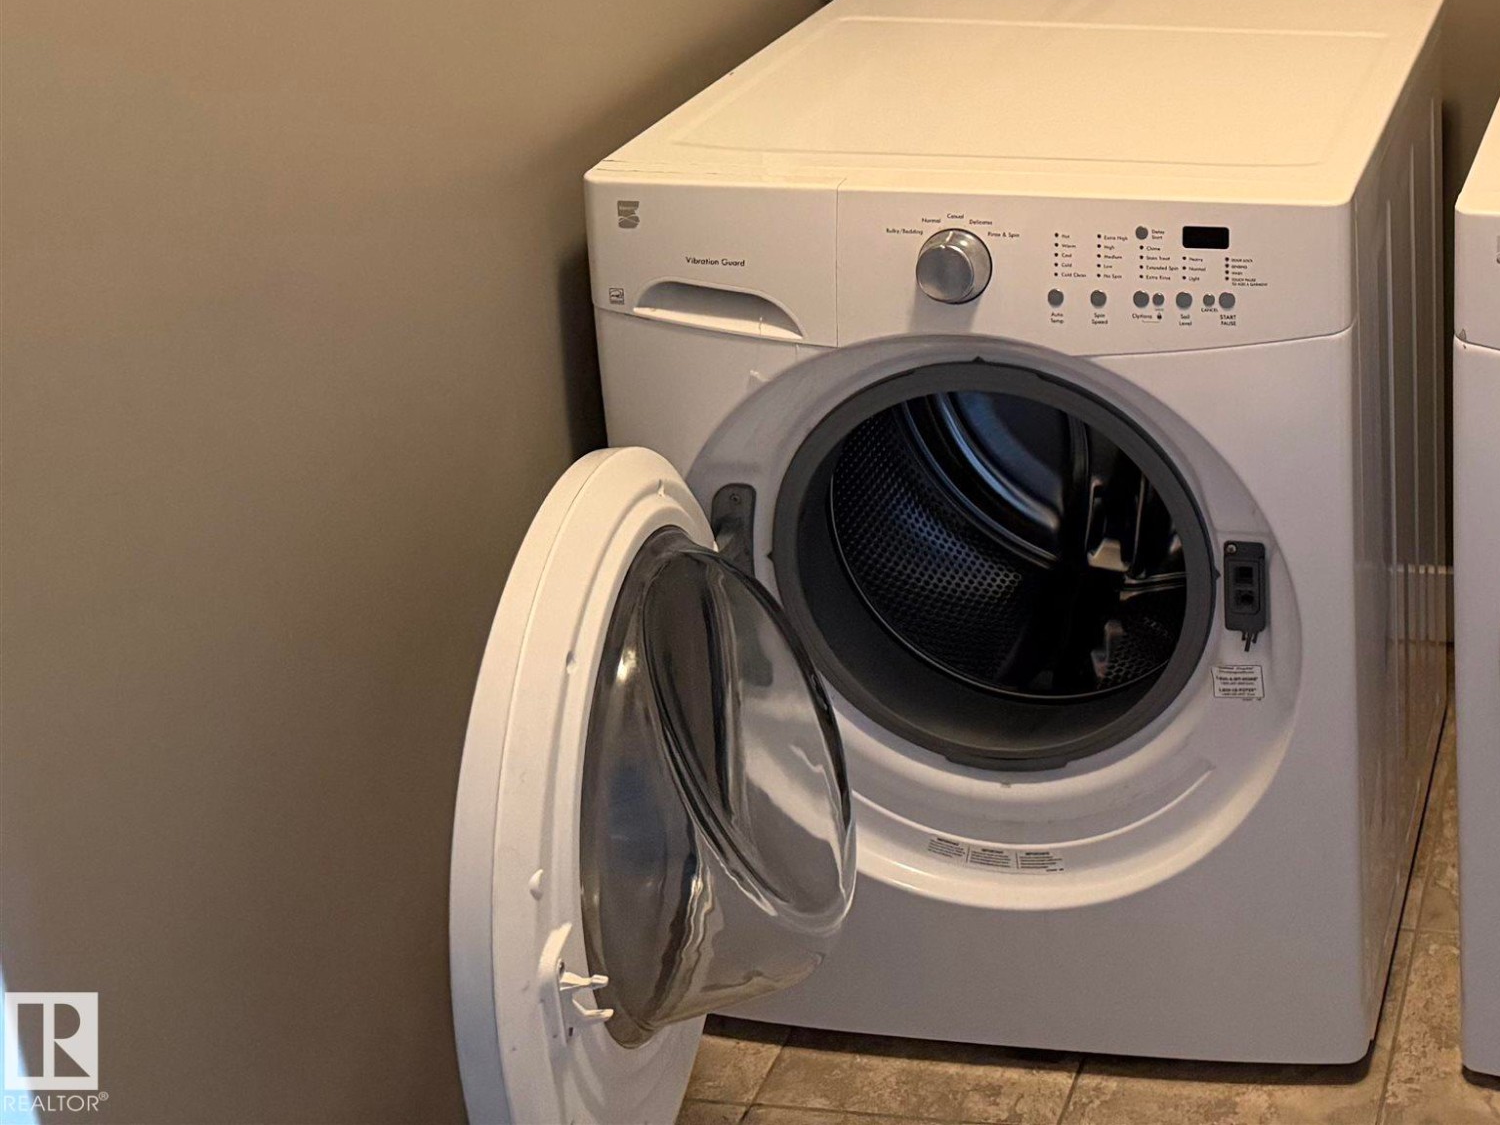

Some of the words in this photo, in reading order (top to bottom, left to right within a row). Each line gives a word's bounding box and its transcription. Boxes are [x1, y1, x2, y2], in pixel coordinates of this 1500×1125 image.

[886, 228, 923, 236] Bulky/Bedding
[685, 256, 720, 267] Vibration
[721, 257, 745, 268] Guard
[1091, 318, 1108, 326] Speed
